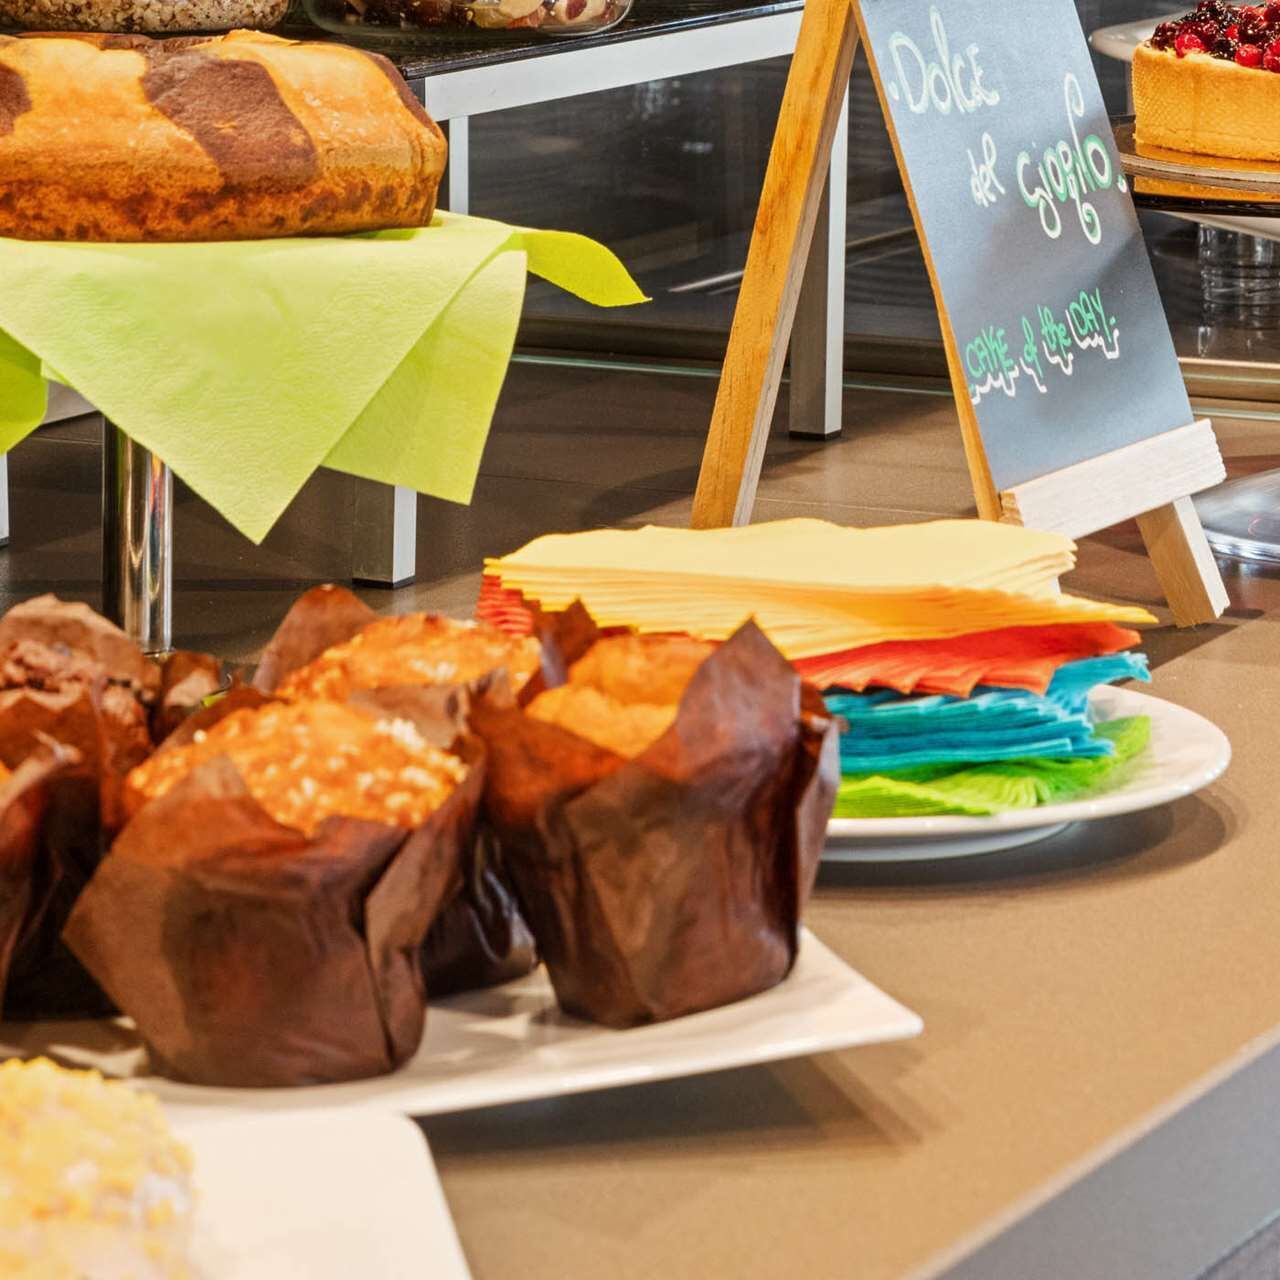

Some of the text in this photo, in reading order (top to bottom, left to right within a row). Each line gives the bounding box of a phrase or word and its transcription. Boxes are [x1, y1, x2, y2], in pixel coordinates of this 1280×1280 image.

[966, 131, 1007, 208] del
[966, 325, 1014, 380] CAKE
[1022, 316, 1044, 379] of
[1037, 303, 1072, 360] the
